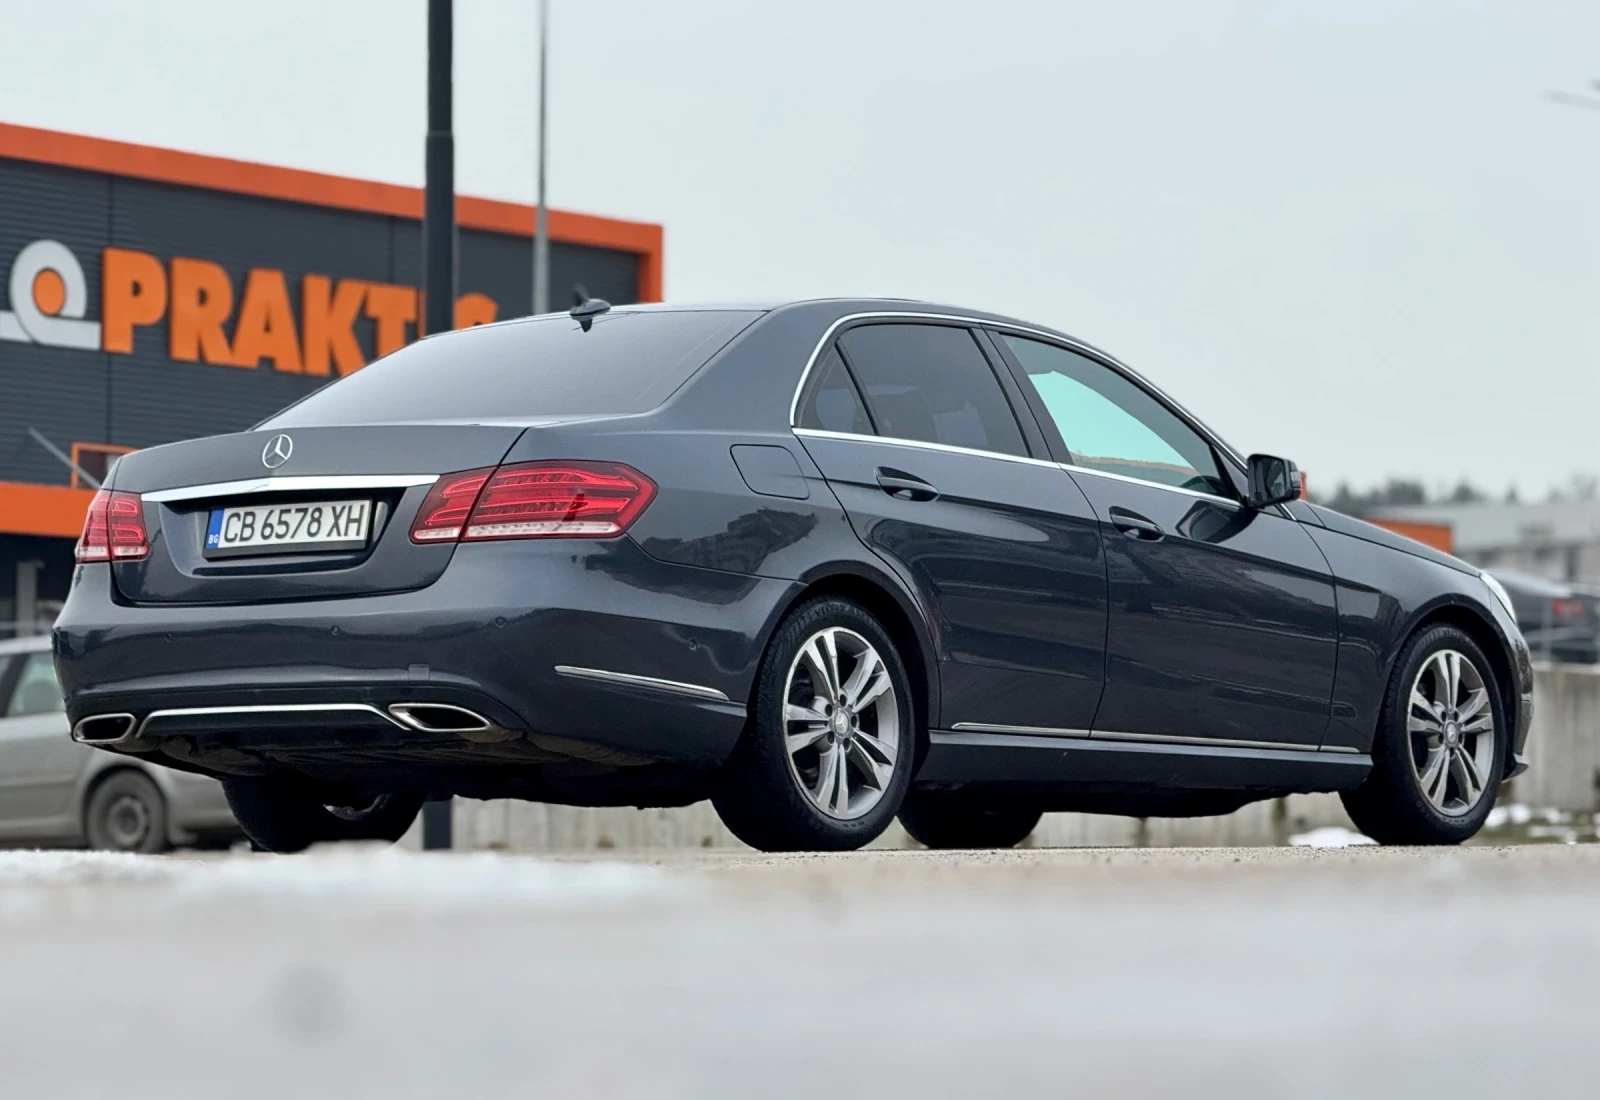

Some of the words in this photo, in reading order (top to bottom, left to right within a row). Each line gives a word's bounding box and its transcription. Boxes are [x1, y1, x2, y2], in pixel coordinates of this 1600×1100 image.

[103, 246, 498, 377] PRAKT
[208, 533, 219, 545] BG
[223, 510, 256, 543] CB
[260, 507, 323, 540] 6578
[326, 504, 365, 538] XH
